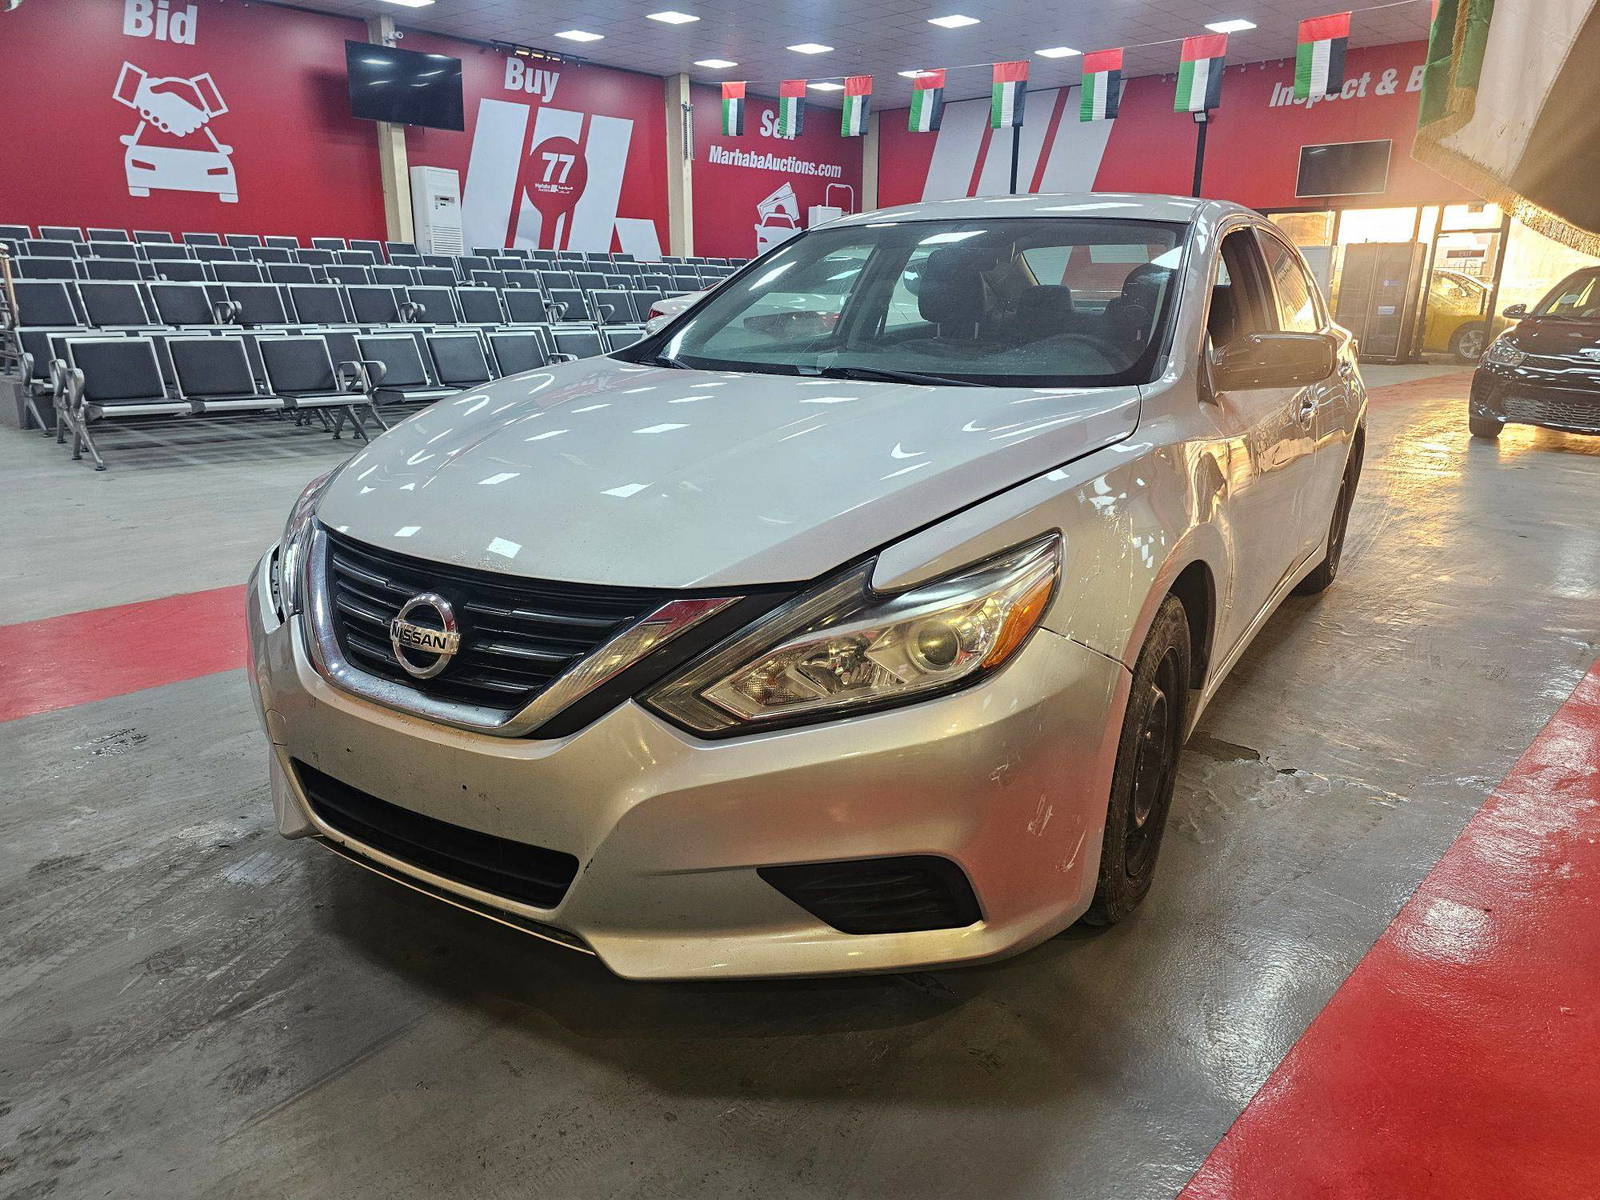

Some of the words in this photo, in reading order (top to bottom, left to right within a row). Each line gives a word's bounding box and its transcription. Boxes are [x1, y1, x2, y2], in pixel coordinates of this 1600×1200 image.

[123, 0, 198, 46] Bid
[504, 56, 560, 103] Buy
[1269, 71, 1371, 109] Inct
[1375, 68, 1399, 96] &
[542, 152, 576, 184] 77
[708, 145, 842, 179] MarhabaAuctions.com
[391, 620, 447, 650] NISSAN
